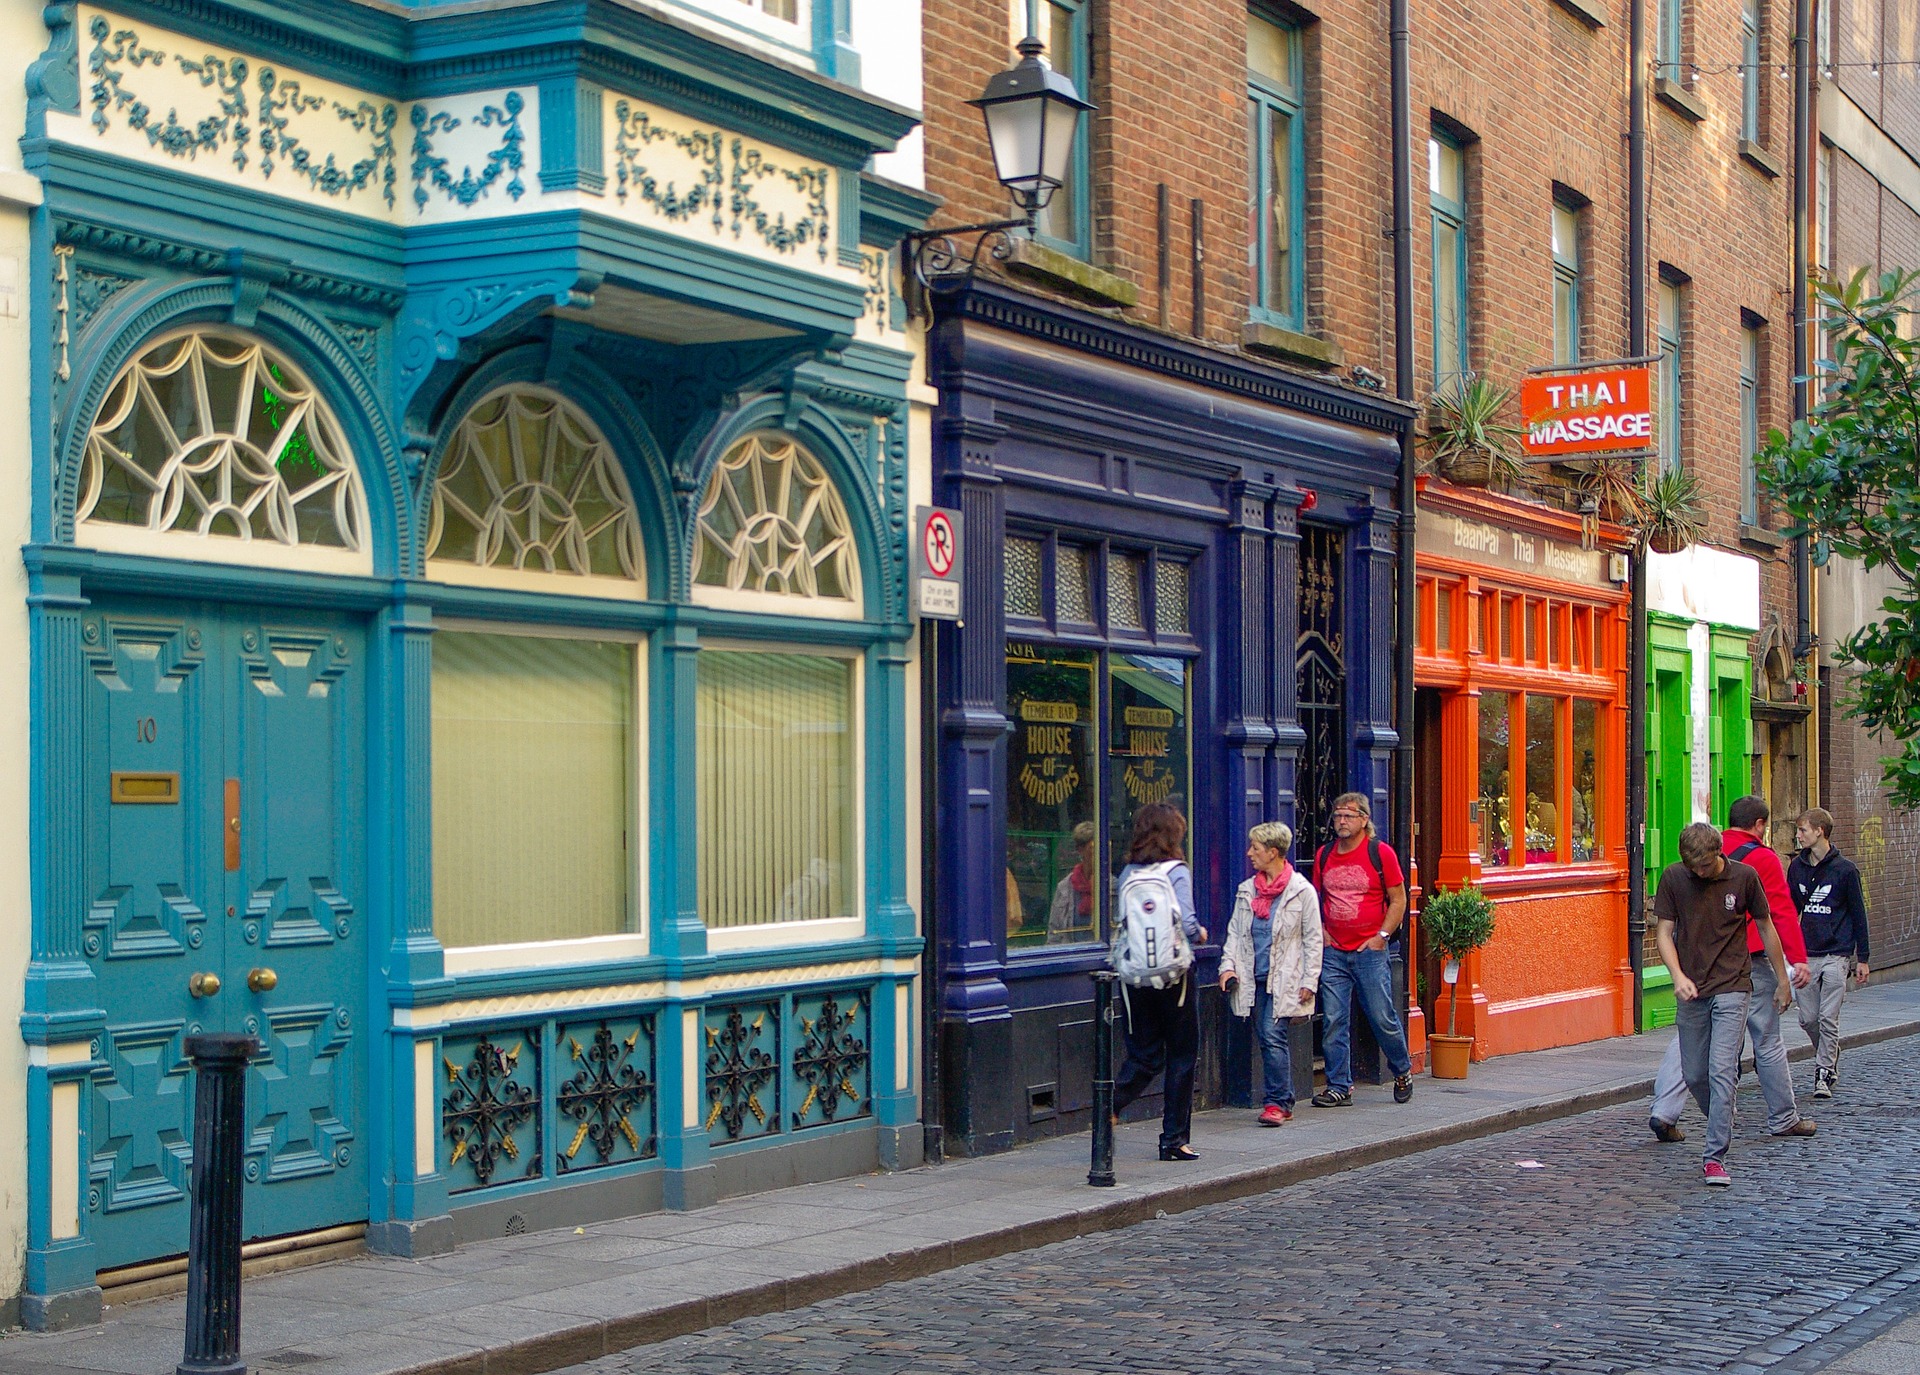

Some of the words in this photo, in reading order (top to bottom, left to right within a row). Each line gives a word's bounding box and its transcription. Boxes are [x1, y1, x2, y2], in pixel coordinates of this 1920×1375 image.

[1546, 379, 1626, 408] THAI
[1529, 413, 1650, 445] MASSAGE
[1454, 519, 1499, 556] BaanPai
[1512, 532, 1534, 564] Thai
[1544, 540, 1588, 579] Massage
[1025, 704, 1054, 720] TEMPLE
[1058, 704, 1074, 720] BAR
[1128, 709, 1154, 725] TEMPLE
[1156, 711, 1171, 726] BAR
[137, 717, 157, 743] 10
[1027, 726, 1072, 755] HOUSE
[1130, 730, 1168, 757] HOUSE
[1041, 757, 1056, 777] OF
[1143, 759, 1156, 778] OF
[1020, 763, 1079, 806] HORRORS
[1123, 764, 1175, 804] HORRORS
[1803, 903, 1832, 915] ddas
